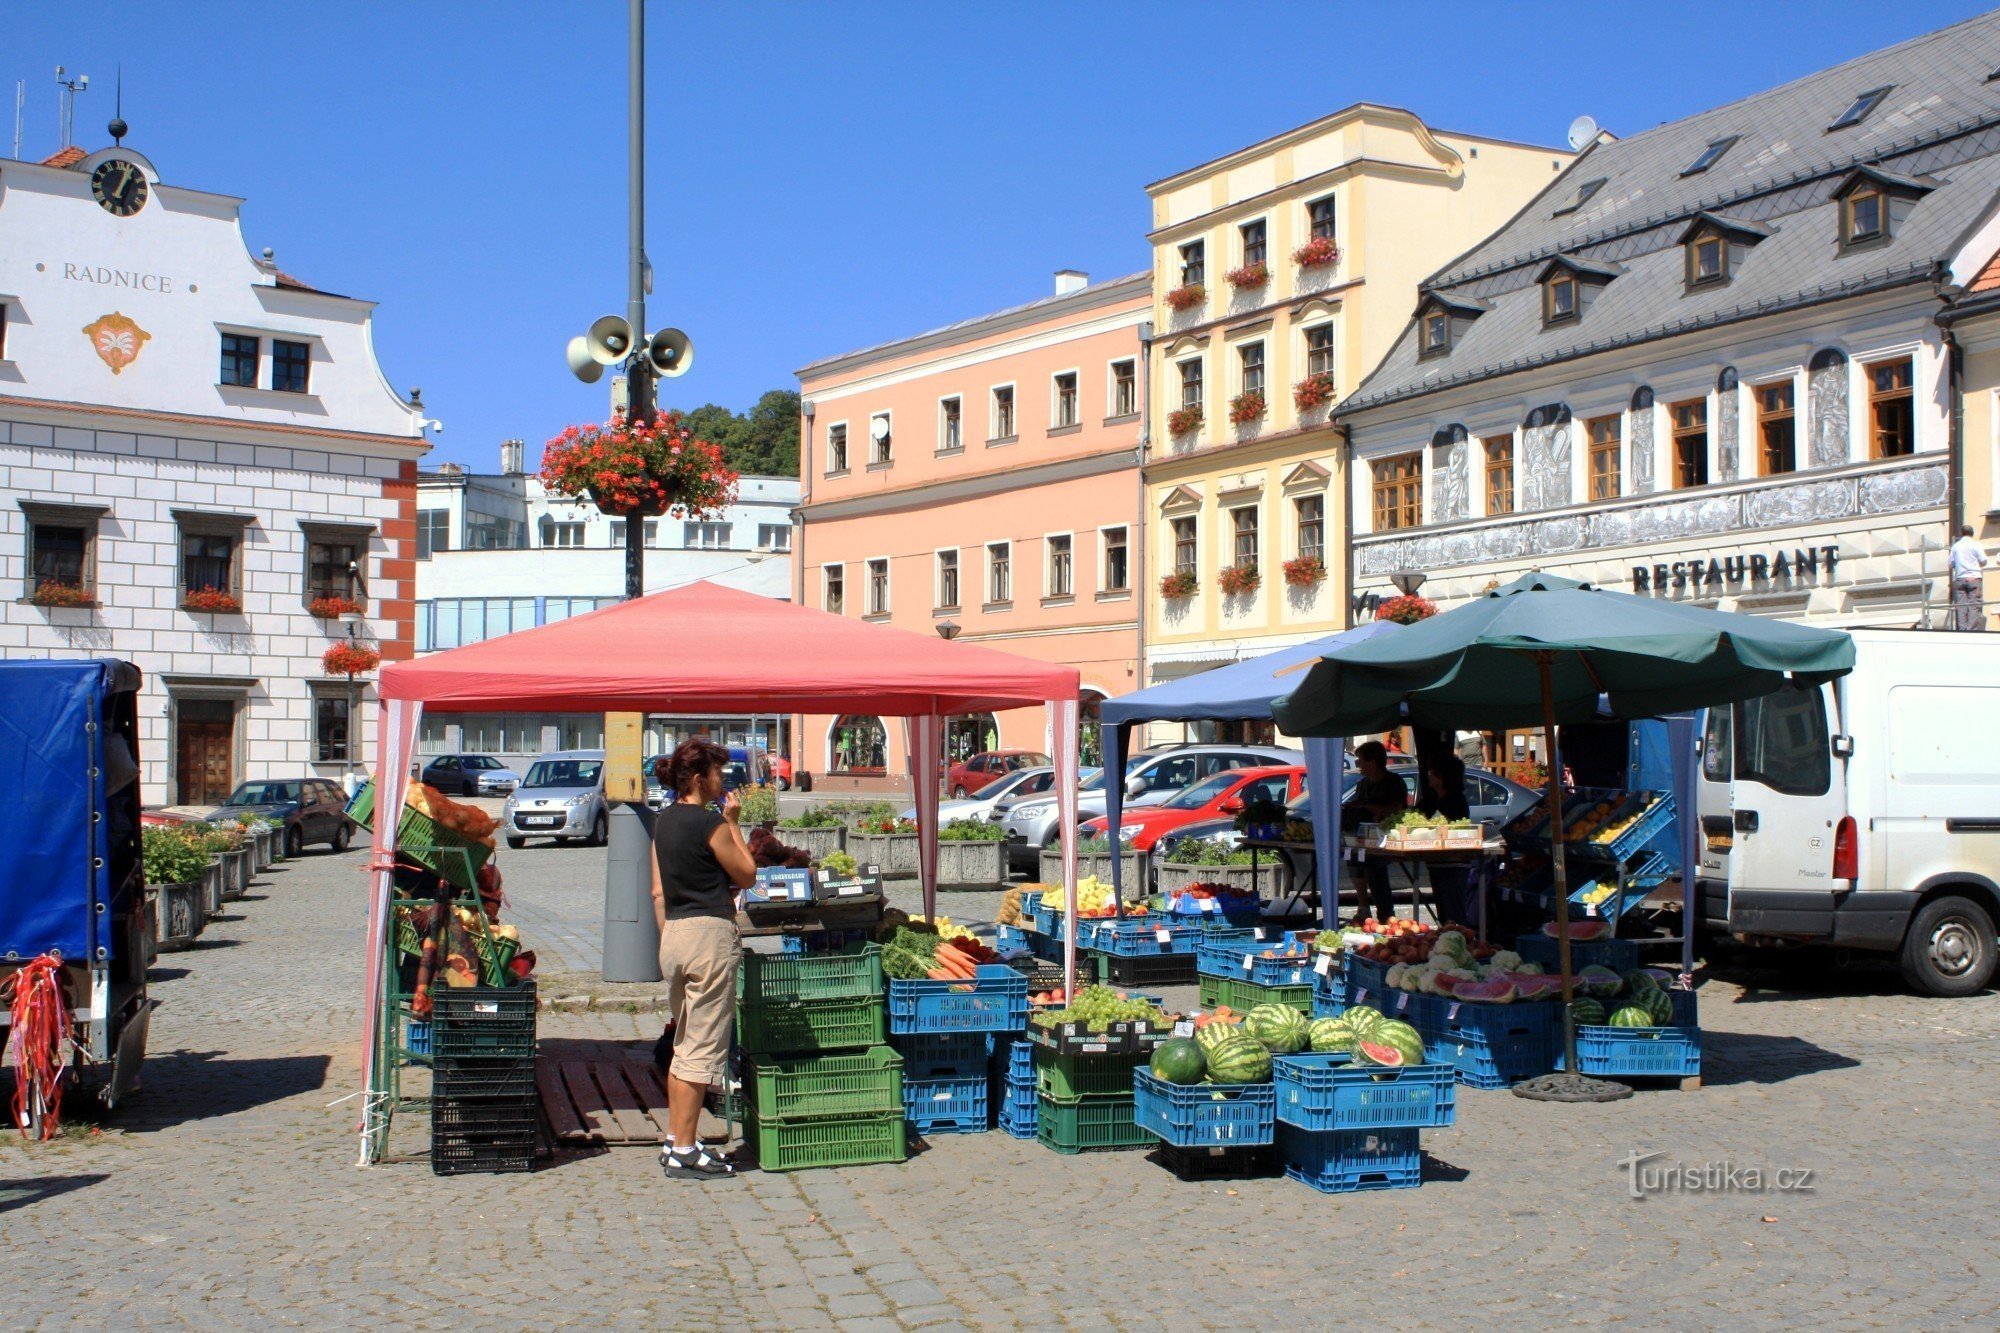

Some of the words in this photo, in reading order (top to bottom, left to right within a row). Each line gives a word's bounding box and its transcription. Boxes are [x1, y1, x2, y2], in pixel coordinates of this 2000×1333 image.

[64, 262, 172, 294] RADNICE
[1632, 545, 1839, 592] RESTAURANT
[1810, 839, 1821, 847] CZ
[1798, 869, 1827, 878] Master
